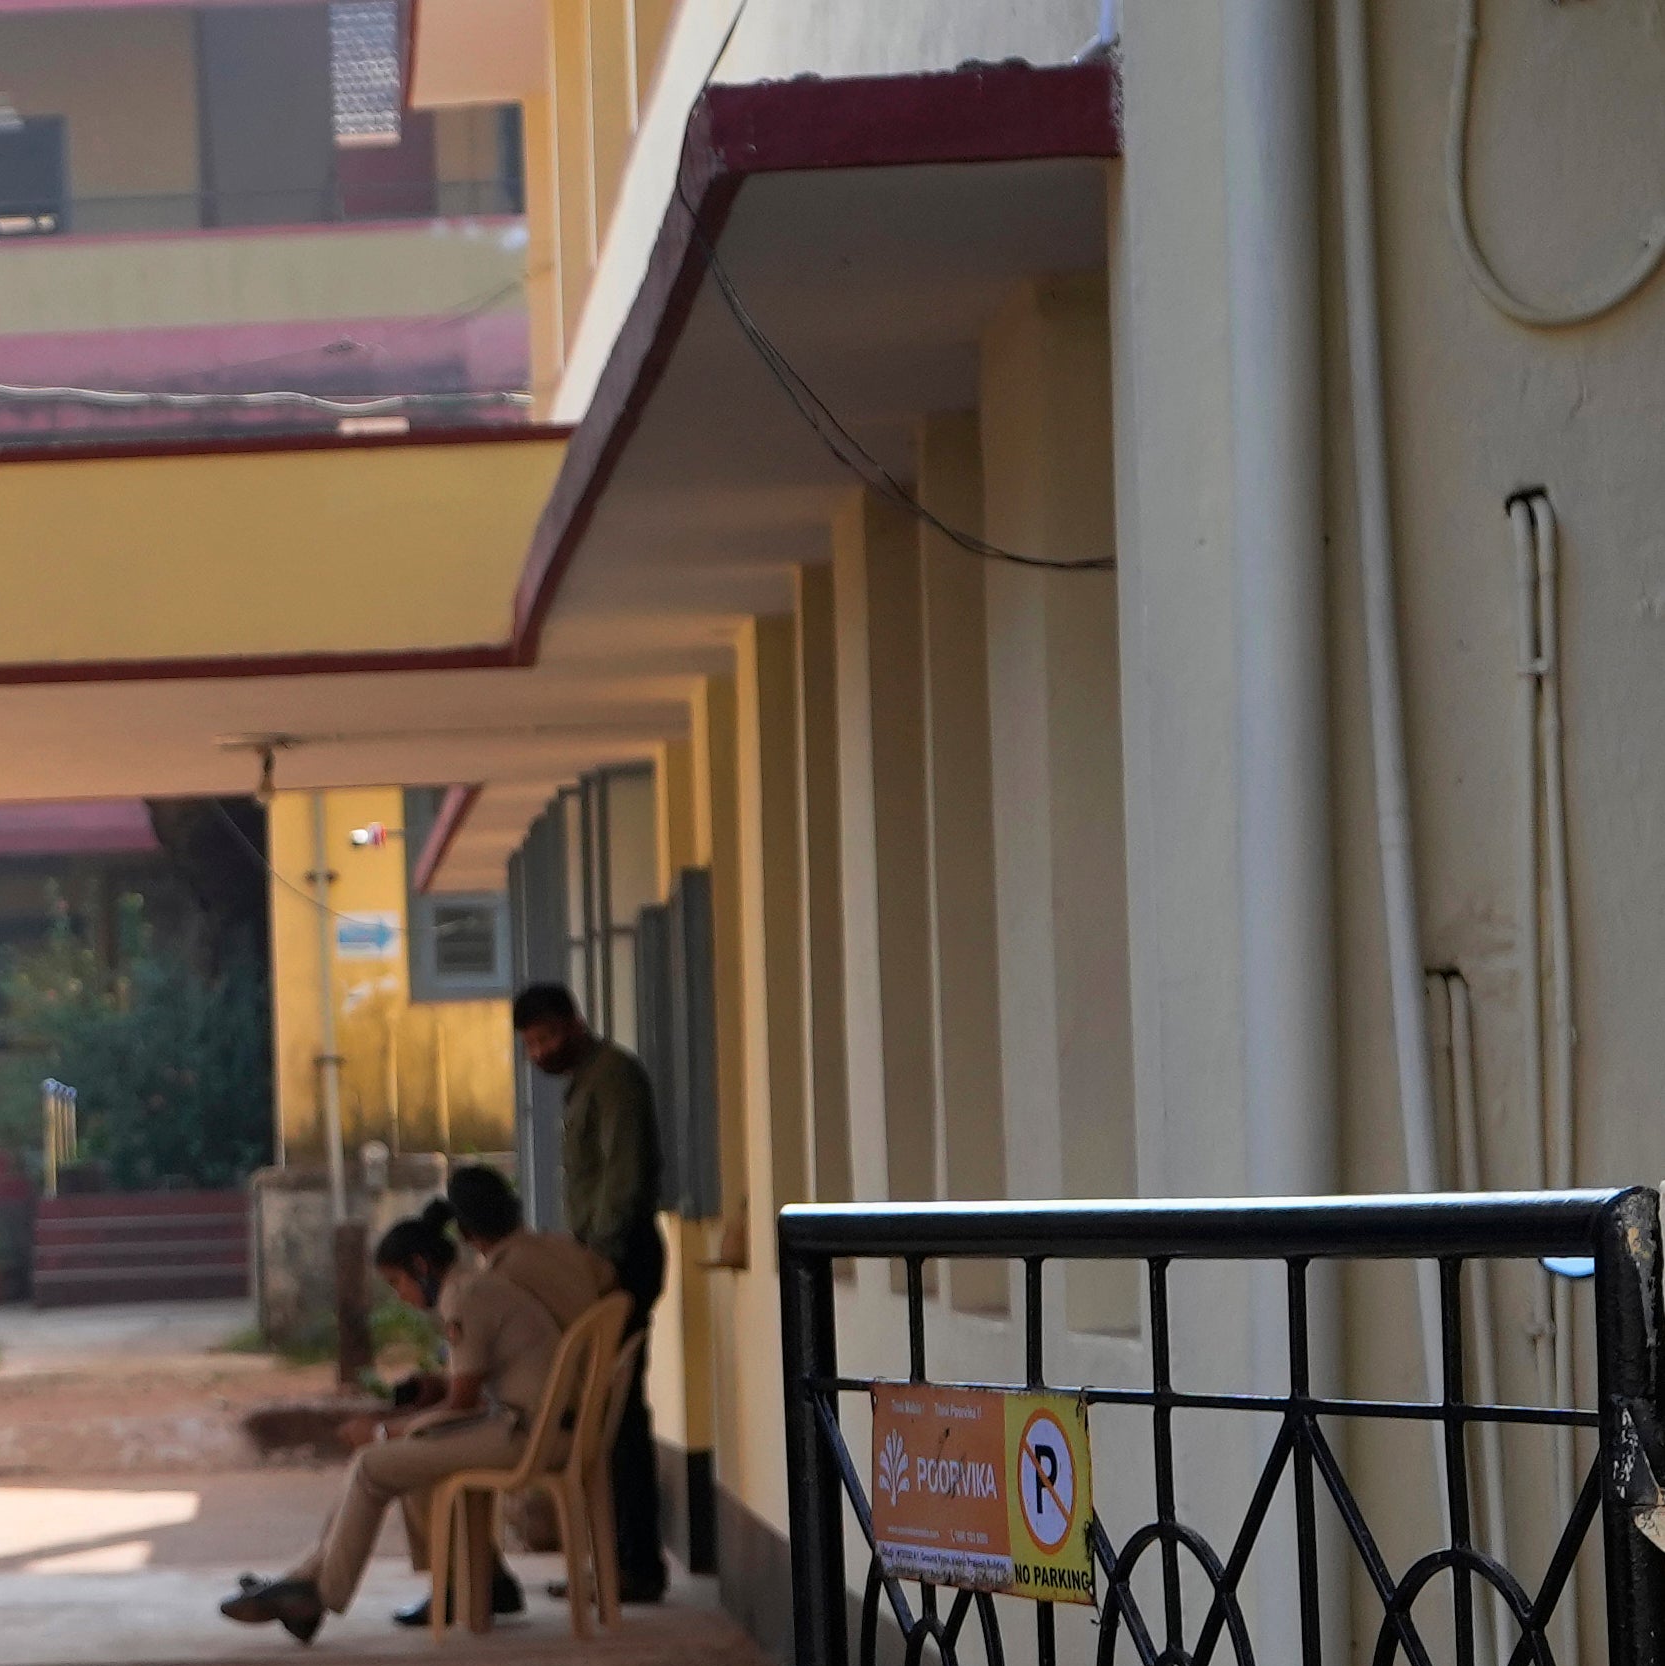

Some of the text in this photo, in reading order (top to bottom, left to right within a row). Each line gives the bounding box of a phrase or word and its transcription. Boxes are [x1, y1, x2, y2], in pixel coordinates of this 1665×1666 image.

[916, 1455, 999, 1501] POORVIKA
[1014, 1563, 1031, 1584] NO
[1033, 1565, 1090, 1592] PARKING
